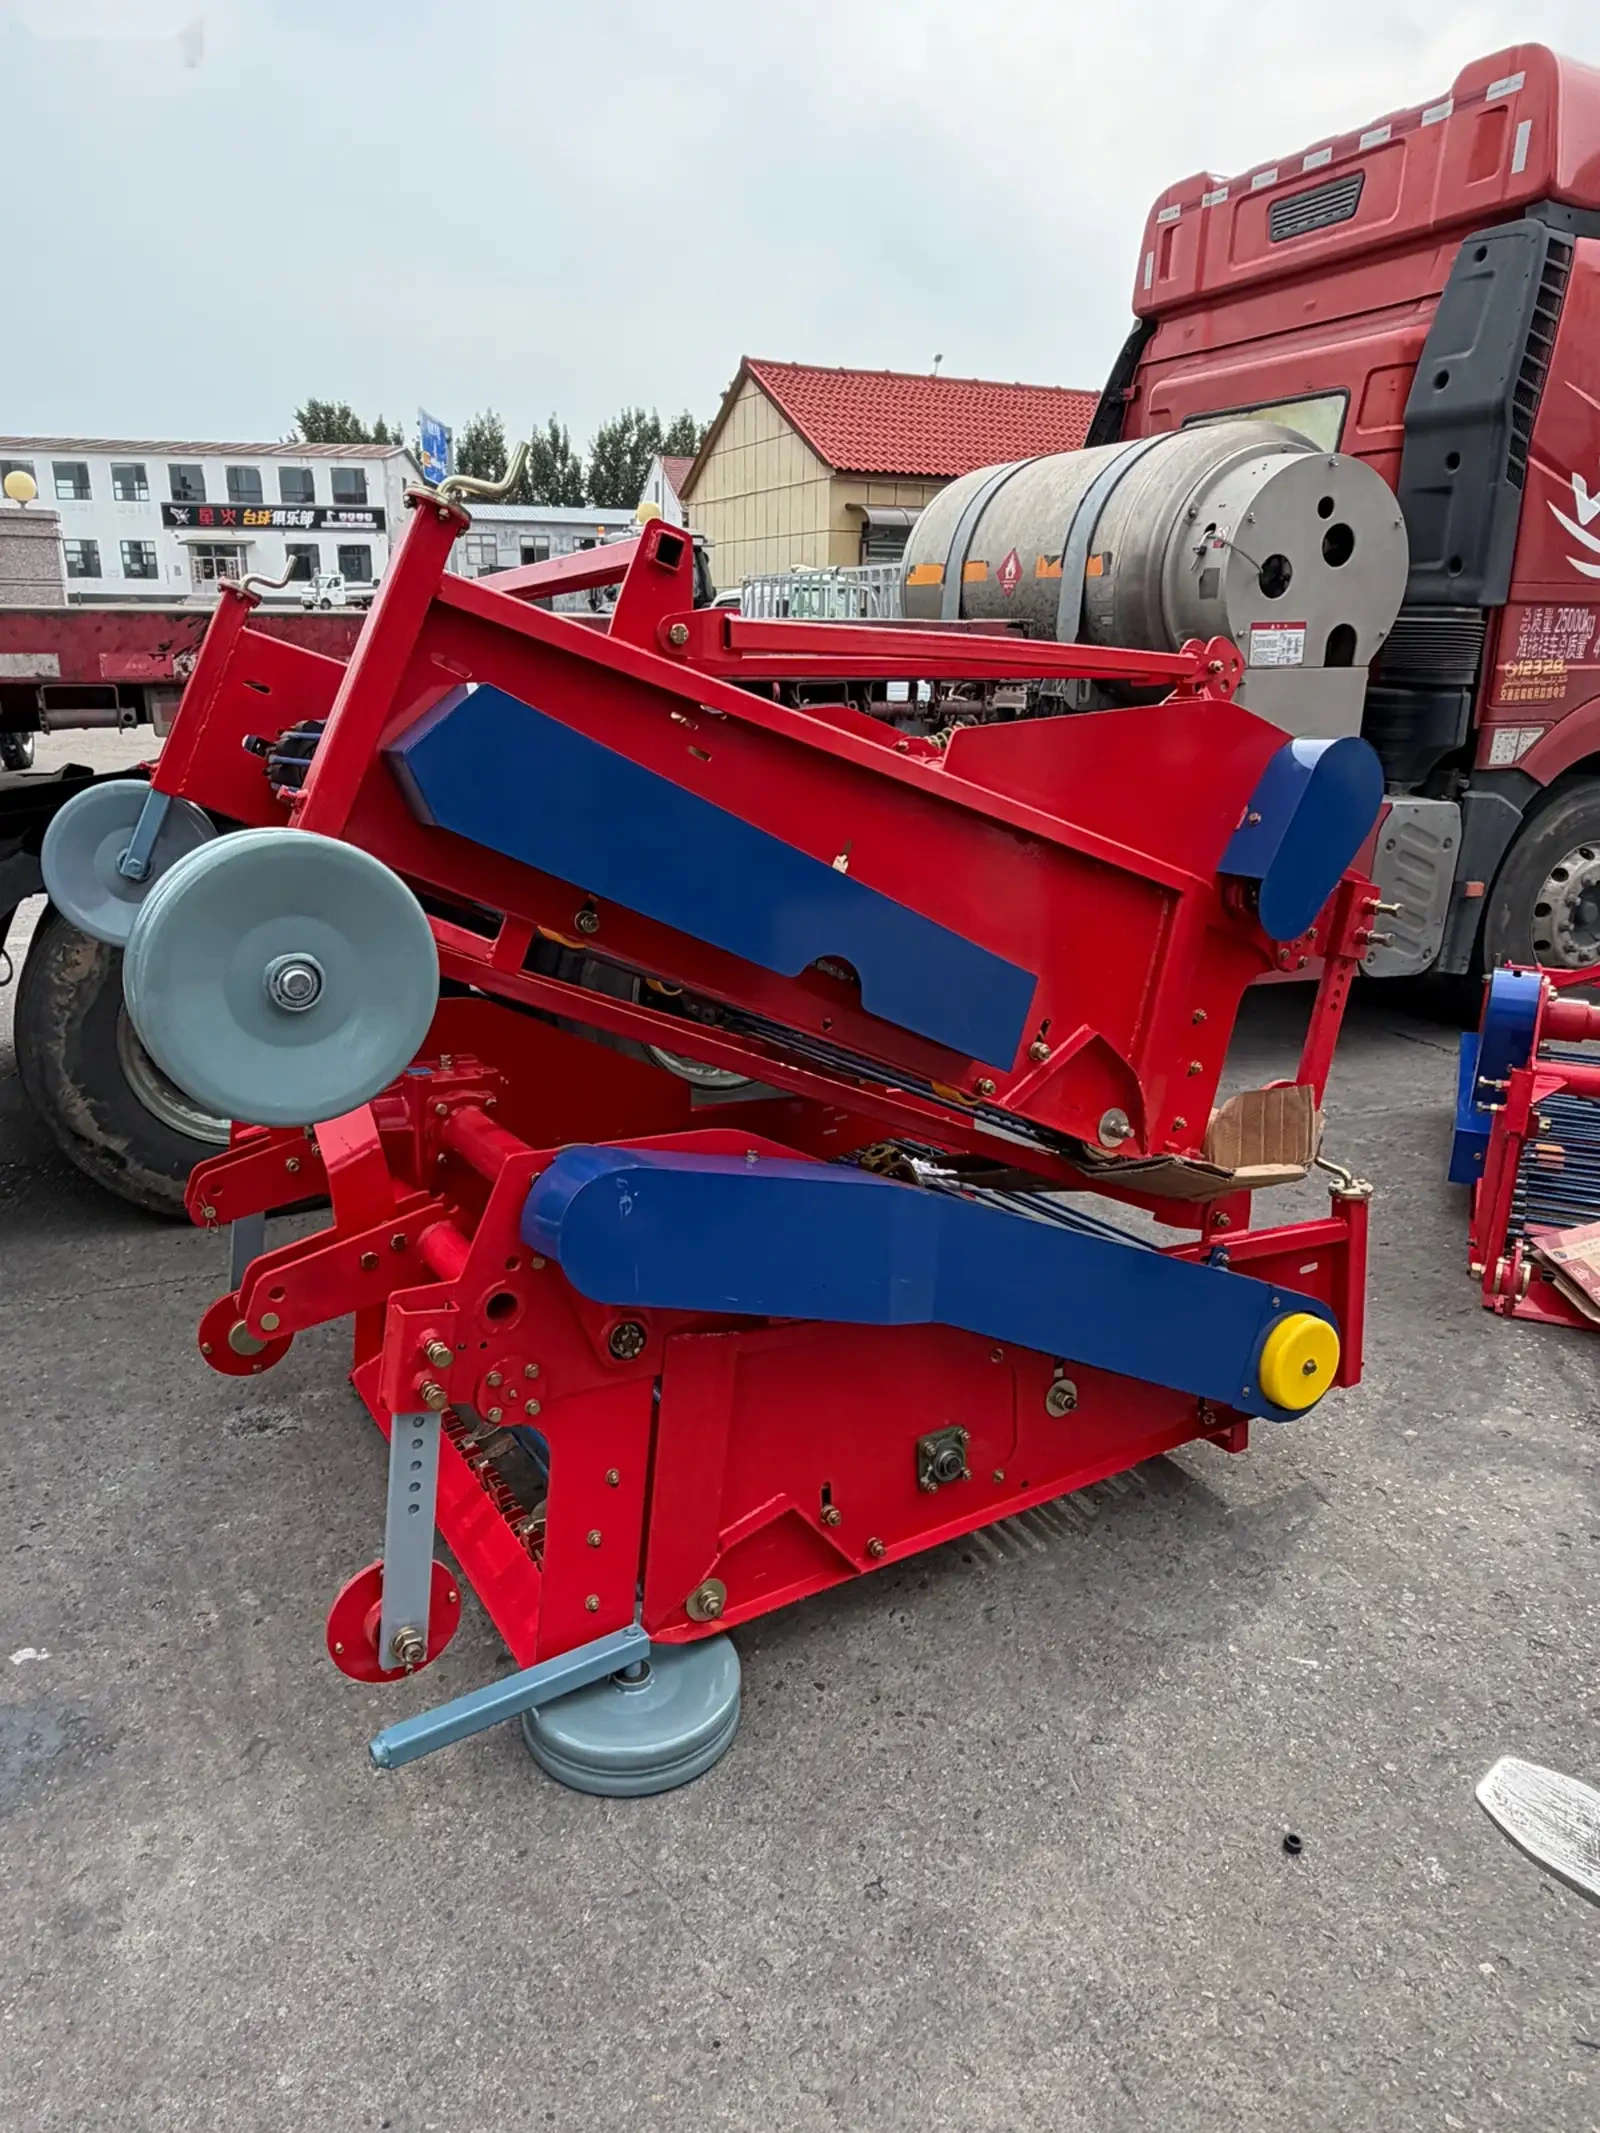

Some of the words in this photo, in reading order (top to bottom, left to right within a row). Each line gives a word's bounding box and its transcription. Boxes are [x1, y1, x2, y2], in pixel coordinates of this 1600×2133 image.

[1519, 608, 1554, 632] 总质量
[1518, 659, 1565, 675] 12328
